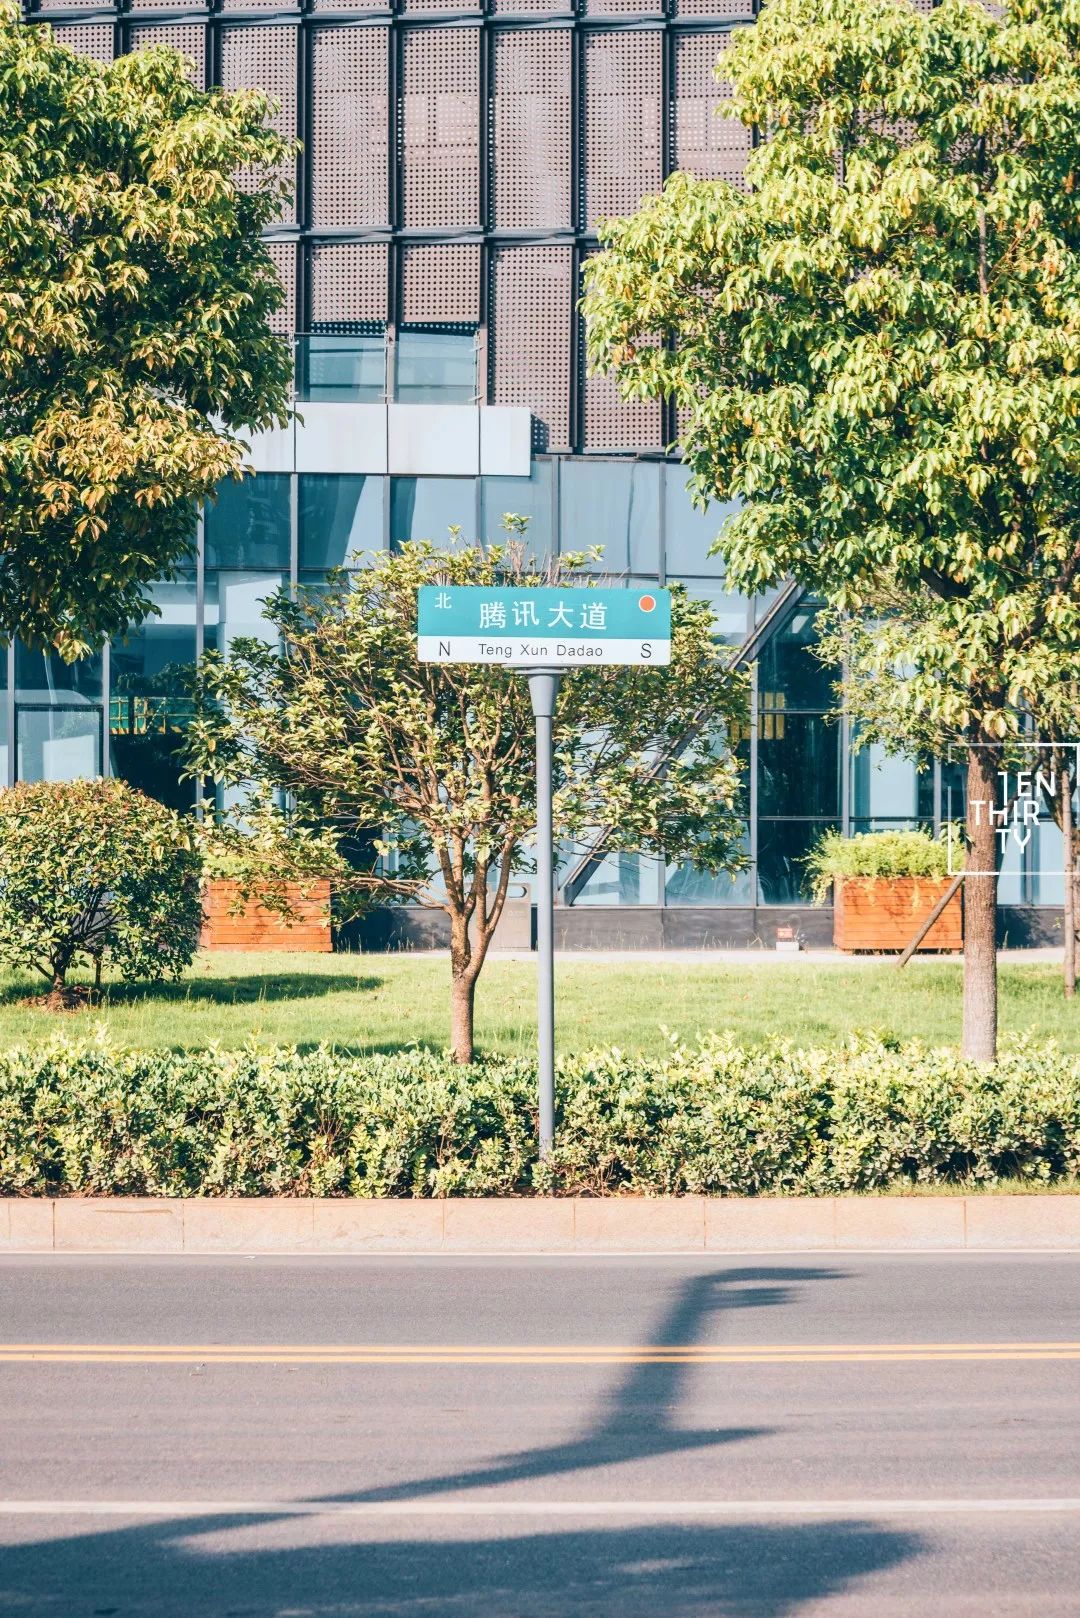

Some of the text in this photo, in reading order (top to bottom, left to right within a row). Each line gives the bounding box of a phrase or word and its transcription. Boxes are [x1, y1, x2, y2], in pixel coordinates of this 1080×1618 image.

[434, 592, 452, 609] 北
[479, 600, 608, 630] 腾讯大道
[438, 641, 451, 657] N
[478, 643, 603, 658] Teng Xun Dadao
[640, 643, 652, 659] S
